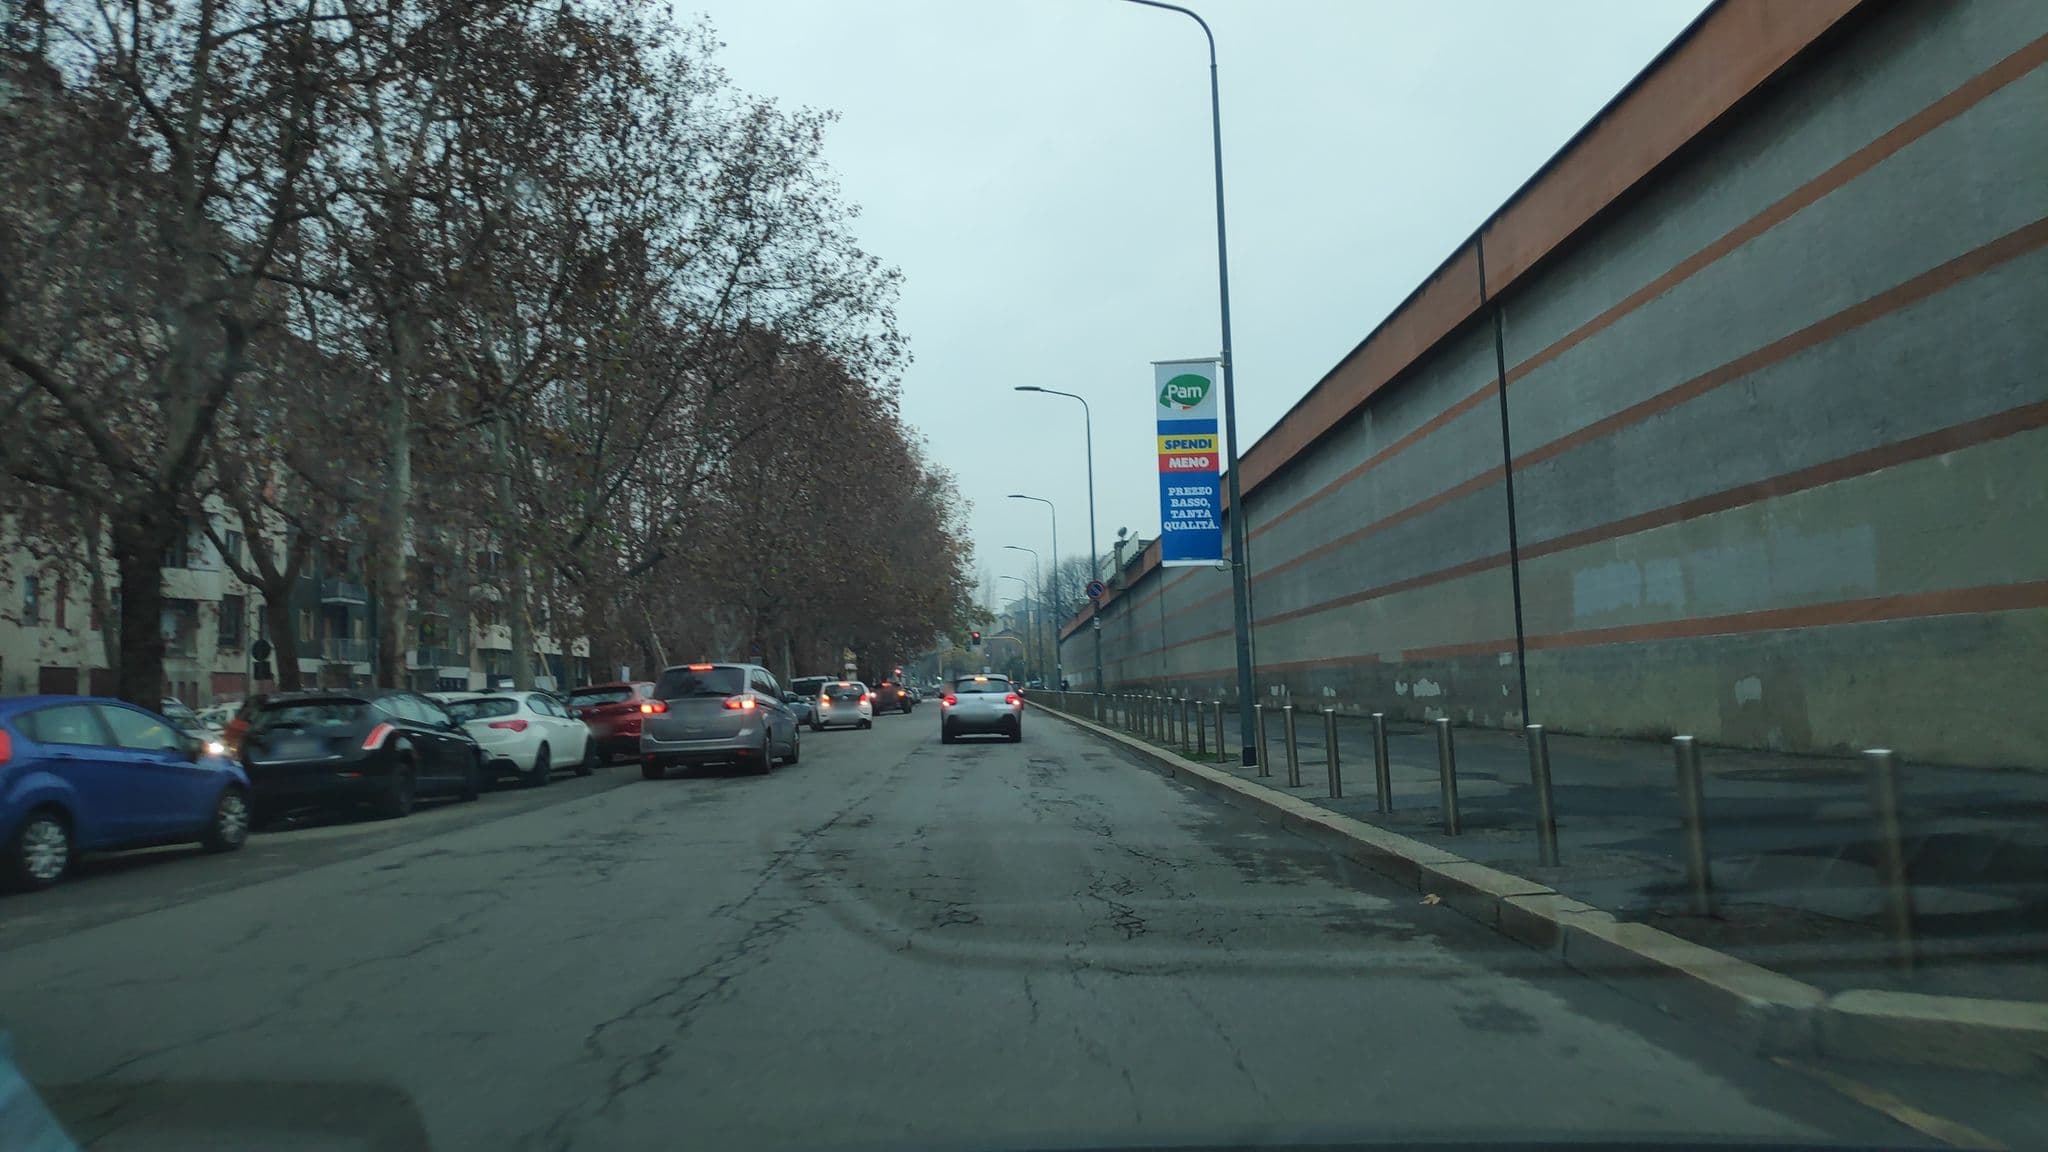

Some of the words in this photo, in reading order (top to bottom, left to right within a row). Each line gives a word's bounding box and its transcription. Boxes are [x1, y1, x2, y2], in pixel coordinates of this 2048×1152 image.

[1168, 384, 1202, 398] Pam
[1164, 439, 1212, 450] SPENDI
[1169, 457, 1210, 469] MENO
[1168, 486, 1213, 496] PREZZO
[1170, 498, 1211, 508] BASSO,
[1170, 509, 1212, 519] TANTA
[1163, 519, 1219, 532] QUALITÀ.
